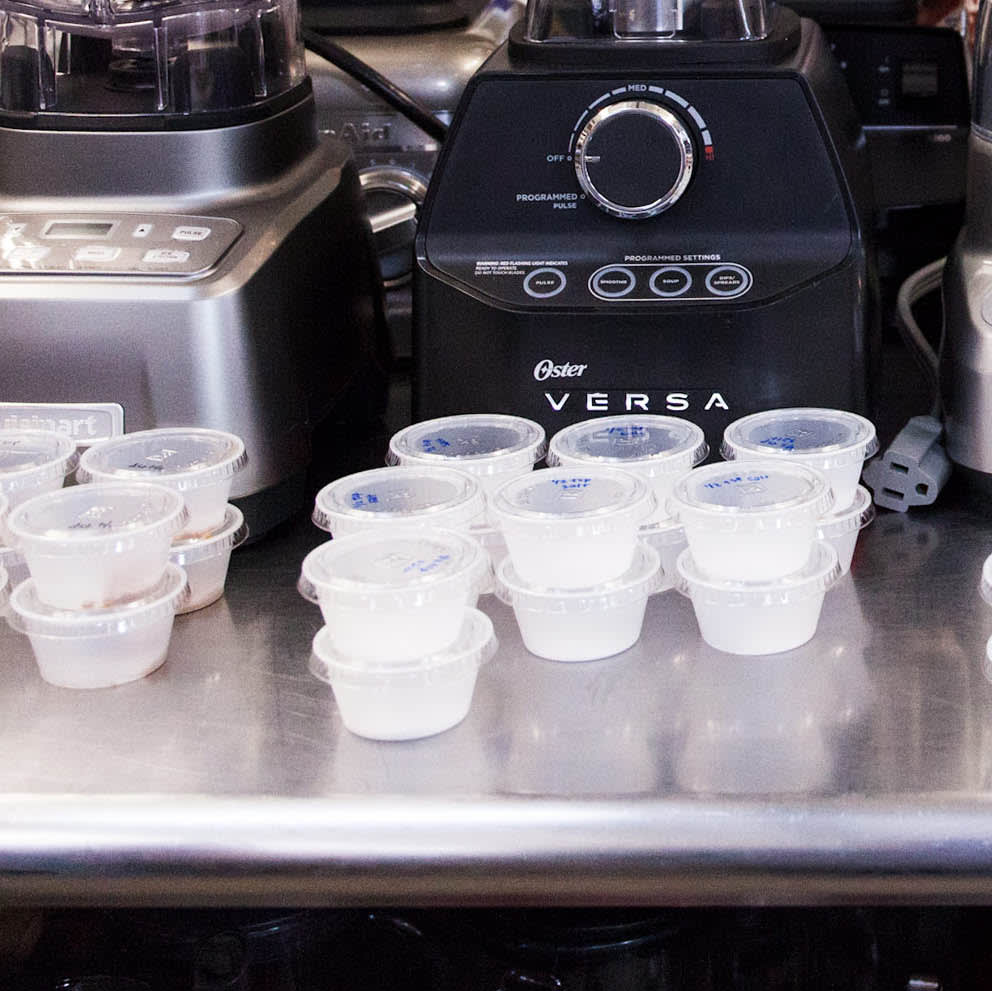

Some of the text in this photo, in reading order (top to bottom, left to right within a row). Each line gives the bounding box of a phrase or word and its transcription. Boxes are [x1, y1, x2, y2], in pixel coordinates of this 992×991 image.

[628, 84, 647, 92] MED
[516, 193, 578, 201] PROGRAMMED
[533, 359, 587, 381] Oster
[545, 392, 729, 411] VERSA
